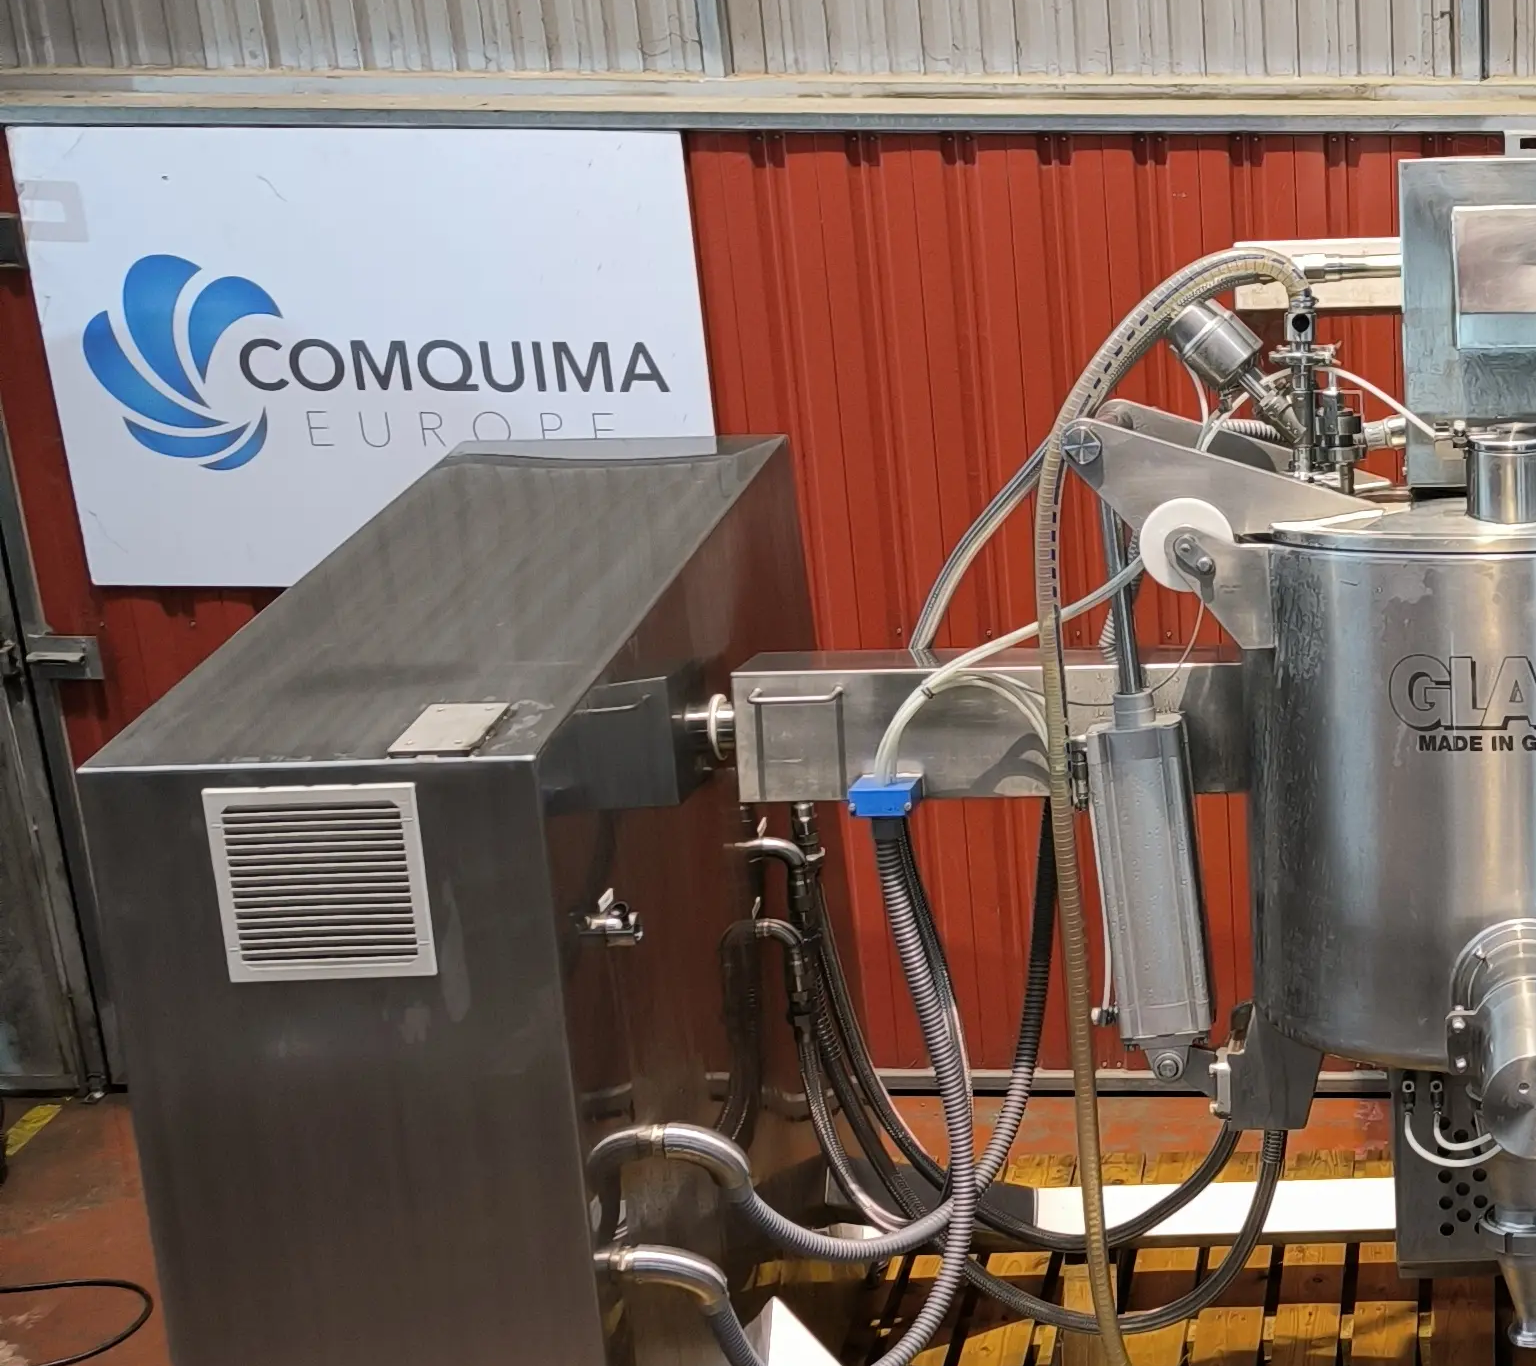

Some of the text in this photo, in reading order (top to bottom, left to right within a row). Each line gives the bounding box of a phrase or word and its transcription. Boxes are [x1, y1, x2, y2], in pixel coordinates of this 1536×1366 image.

[239, 338, 671, 393] COMQUIMA
[1418, 735, 1483, 752] MADE
[1491, 735, 1514, 751] IN
